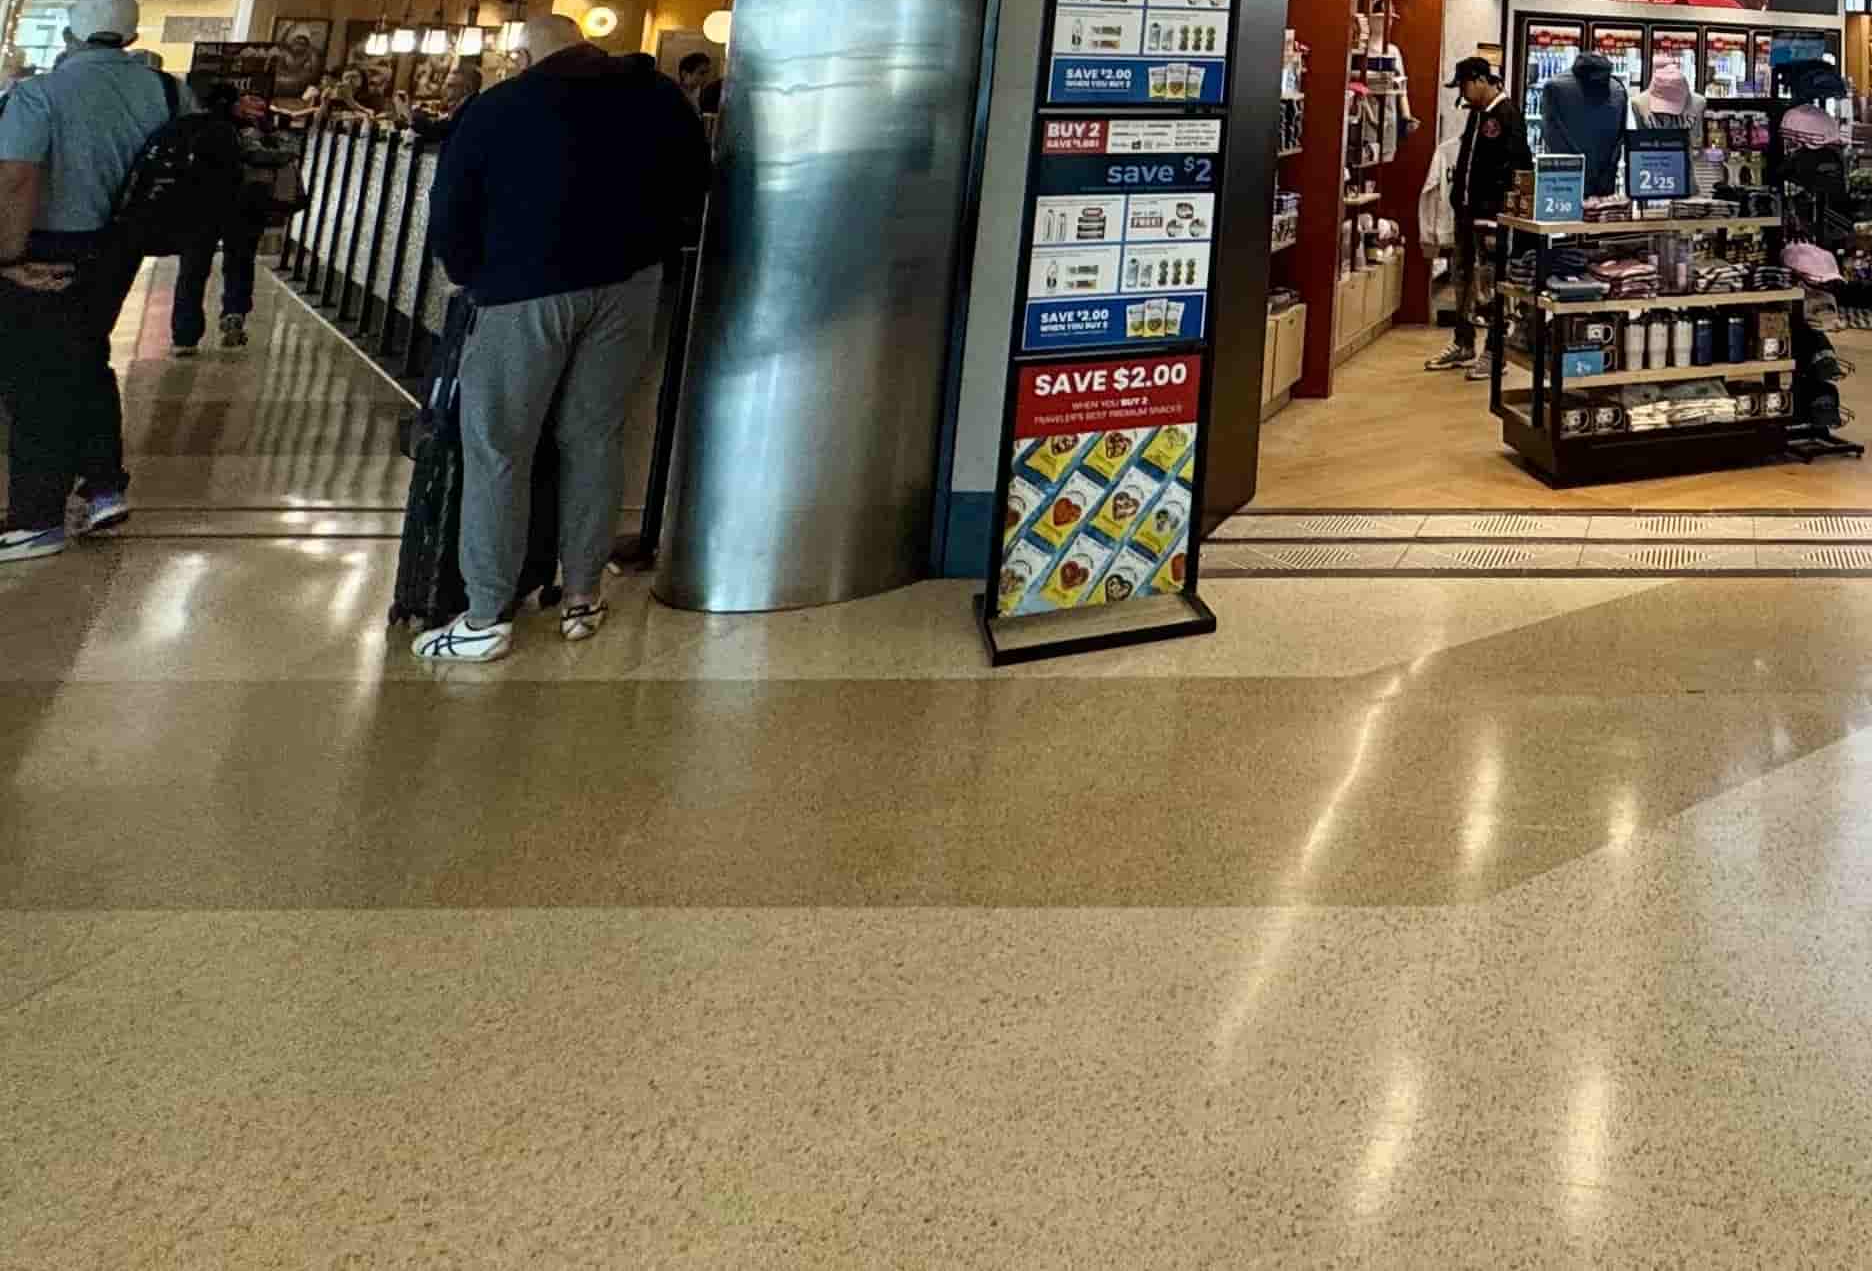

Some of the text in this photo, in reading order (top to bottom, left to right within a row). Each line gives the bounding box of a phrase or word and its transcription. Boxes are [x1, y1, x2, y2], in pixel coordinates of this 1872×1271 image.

[1065, 68, 1099, 80] SAVE
[1047, 122, 1087, 138] BUY
[1087, 122, 1101, 138] 2
[1106, 155, 1213, 183] save $2
[1040, 310, 1075, 324] SAVE
[1033, 362, 1188, 397] SAVE $2.00
